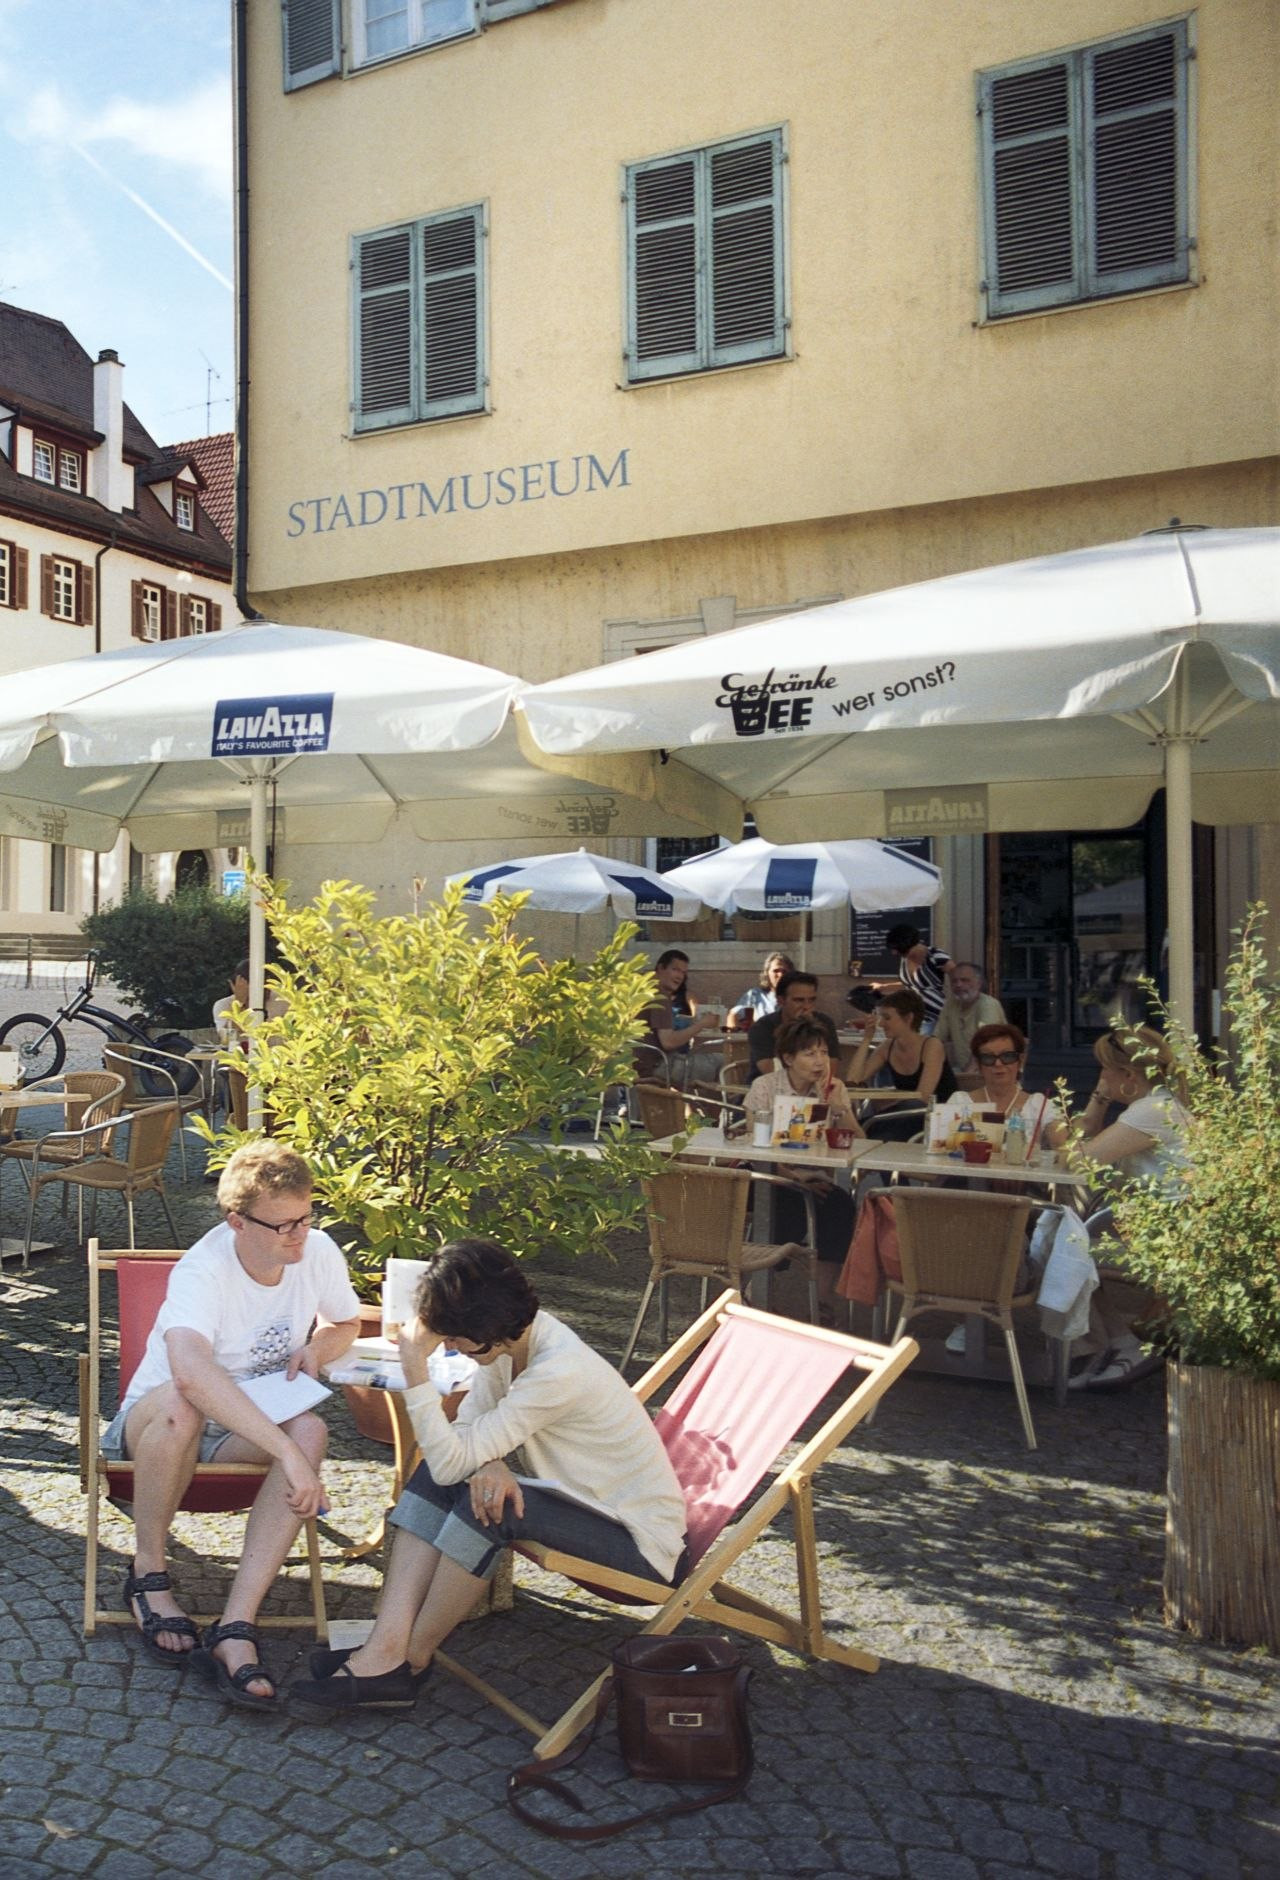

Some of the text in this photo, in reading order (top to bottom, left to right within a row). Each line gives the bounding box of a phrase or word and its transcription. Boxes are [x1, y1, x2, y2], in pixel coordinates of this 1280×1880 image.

[286, 448, 632, 538] STADTMUSEUM
[832, 661, 956, 718] wer sonst?
[216, 706, 325, 740] LAVAZZA
[731, 697, 814, 736] BEE
[216, 737, 325, 751] ITALY'S FAVOURITE COFFEE
